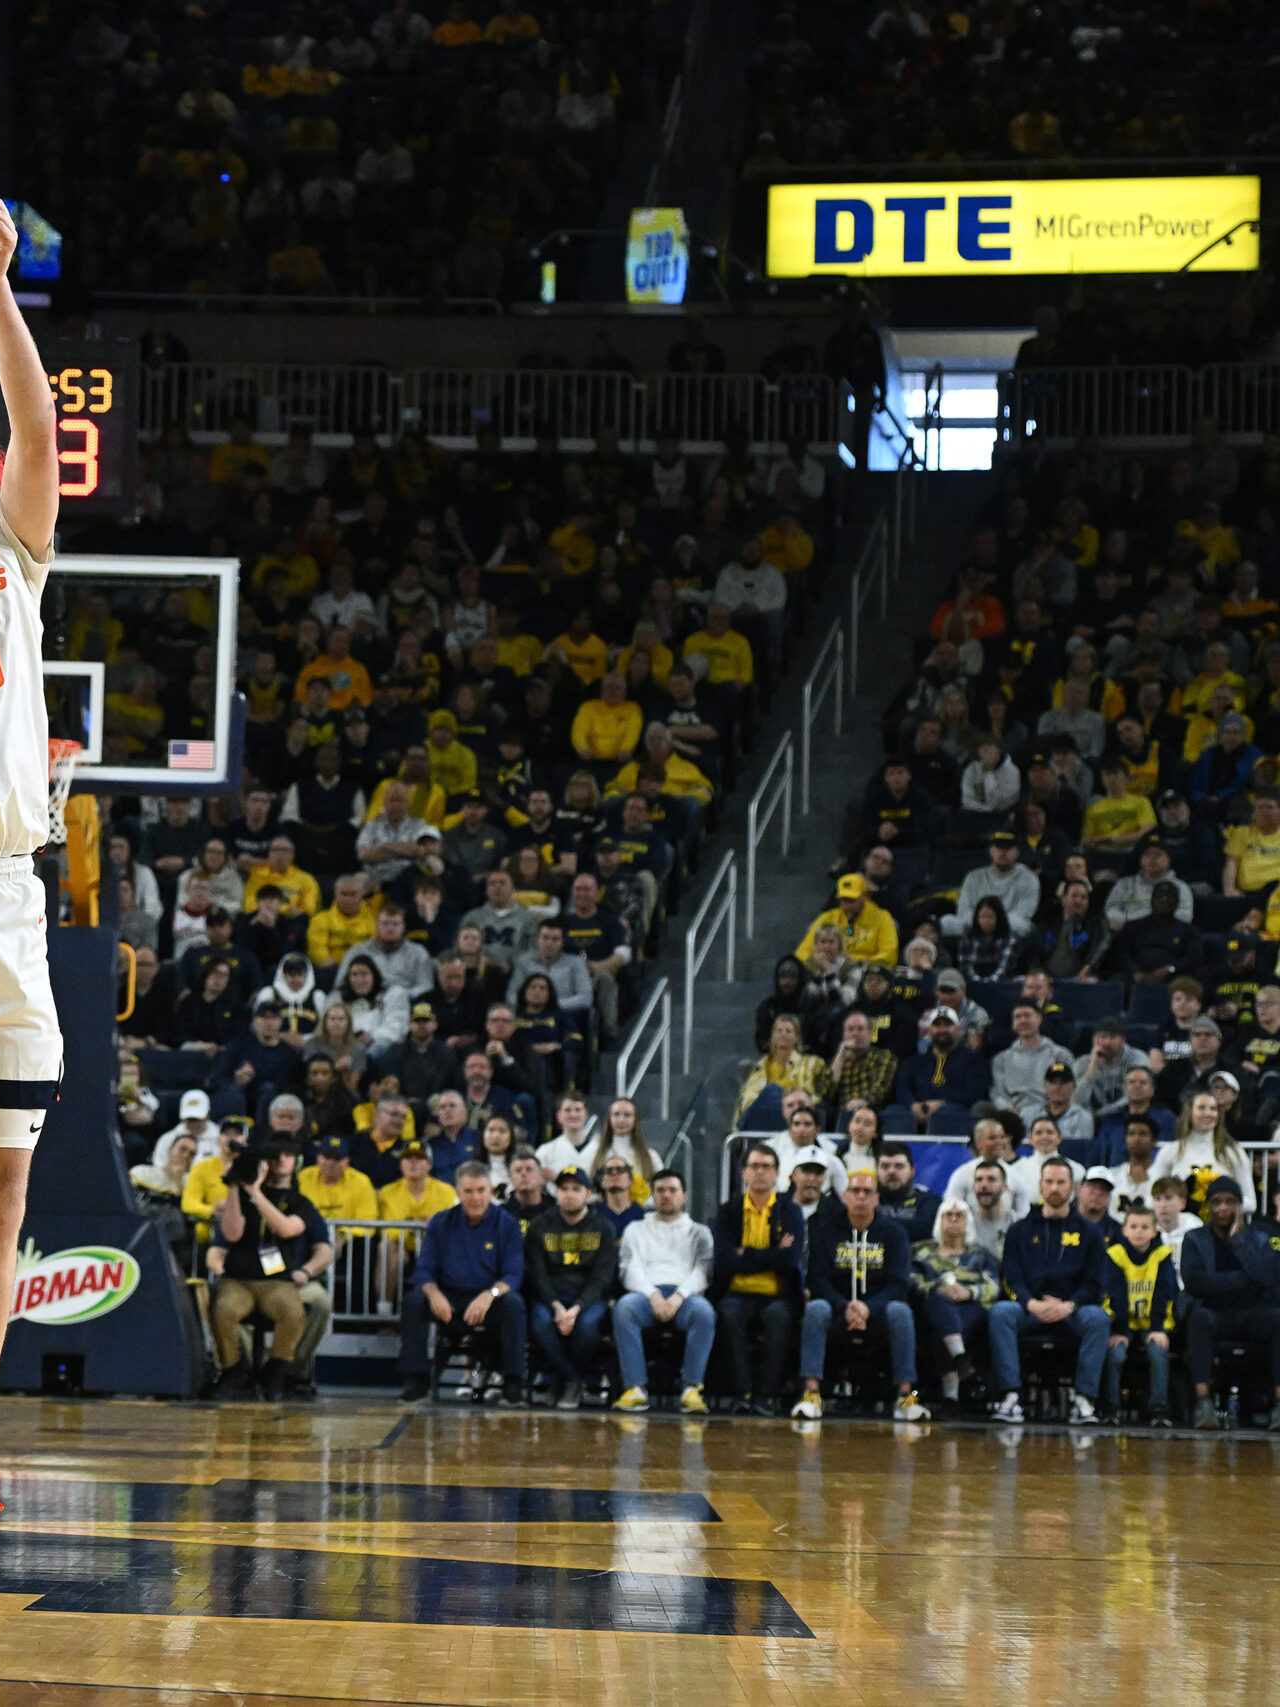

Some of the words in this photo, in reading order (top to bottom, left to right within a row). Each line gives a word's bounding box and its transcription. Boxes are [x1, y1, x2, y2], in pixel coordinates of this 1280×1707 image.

[815, 196, 1012, 264] DTE
[1035, 213, 1214, 239] MIGreenPower
[45, 368, 113, 414] :53
[10, 1261, 124, 1316] IBMAN
